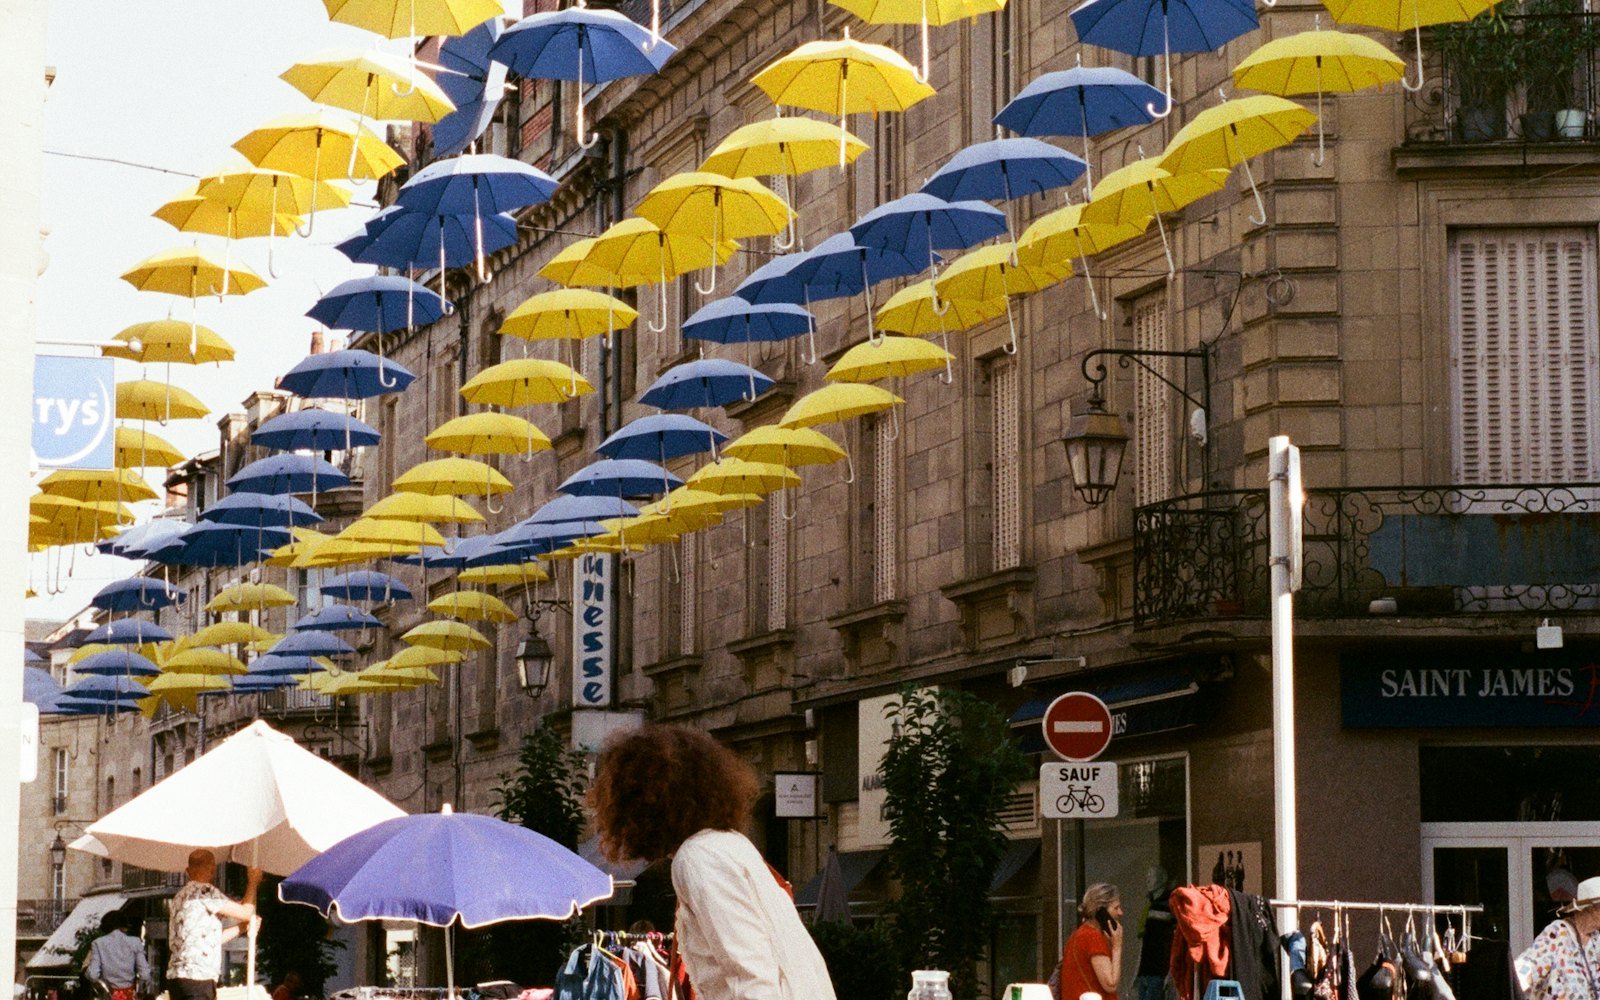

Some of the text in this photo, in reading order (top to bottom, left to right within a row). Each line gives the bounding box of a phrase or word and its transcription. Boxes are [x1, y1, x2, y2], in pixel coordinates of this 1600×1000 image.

[34, 392, 100, 435] rys
[1380, 668, 1472, 698] SAINT
[1478, 668, 1575, 697] JAMES
[1059, 767, 1101, 782] SAUF
